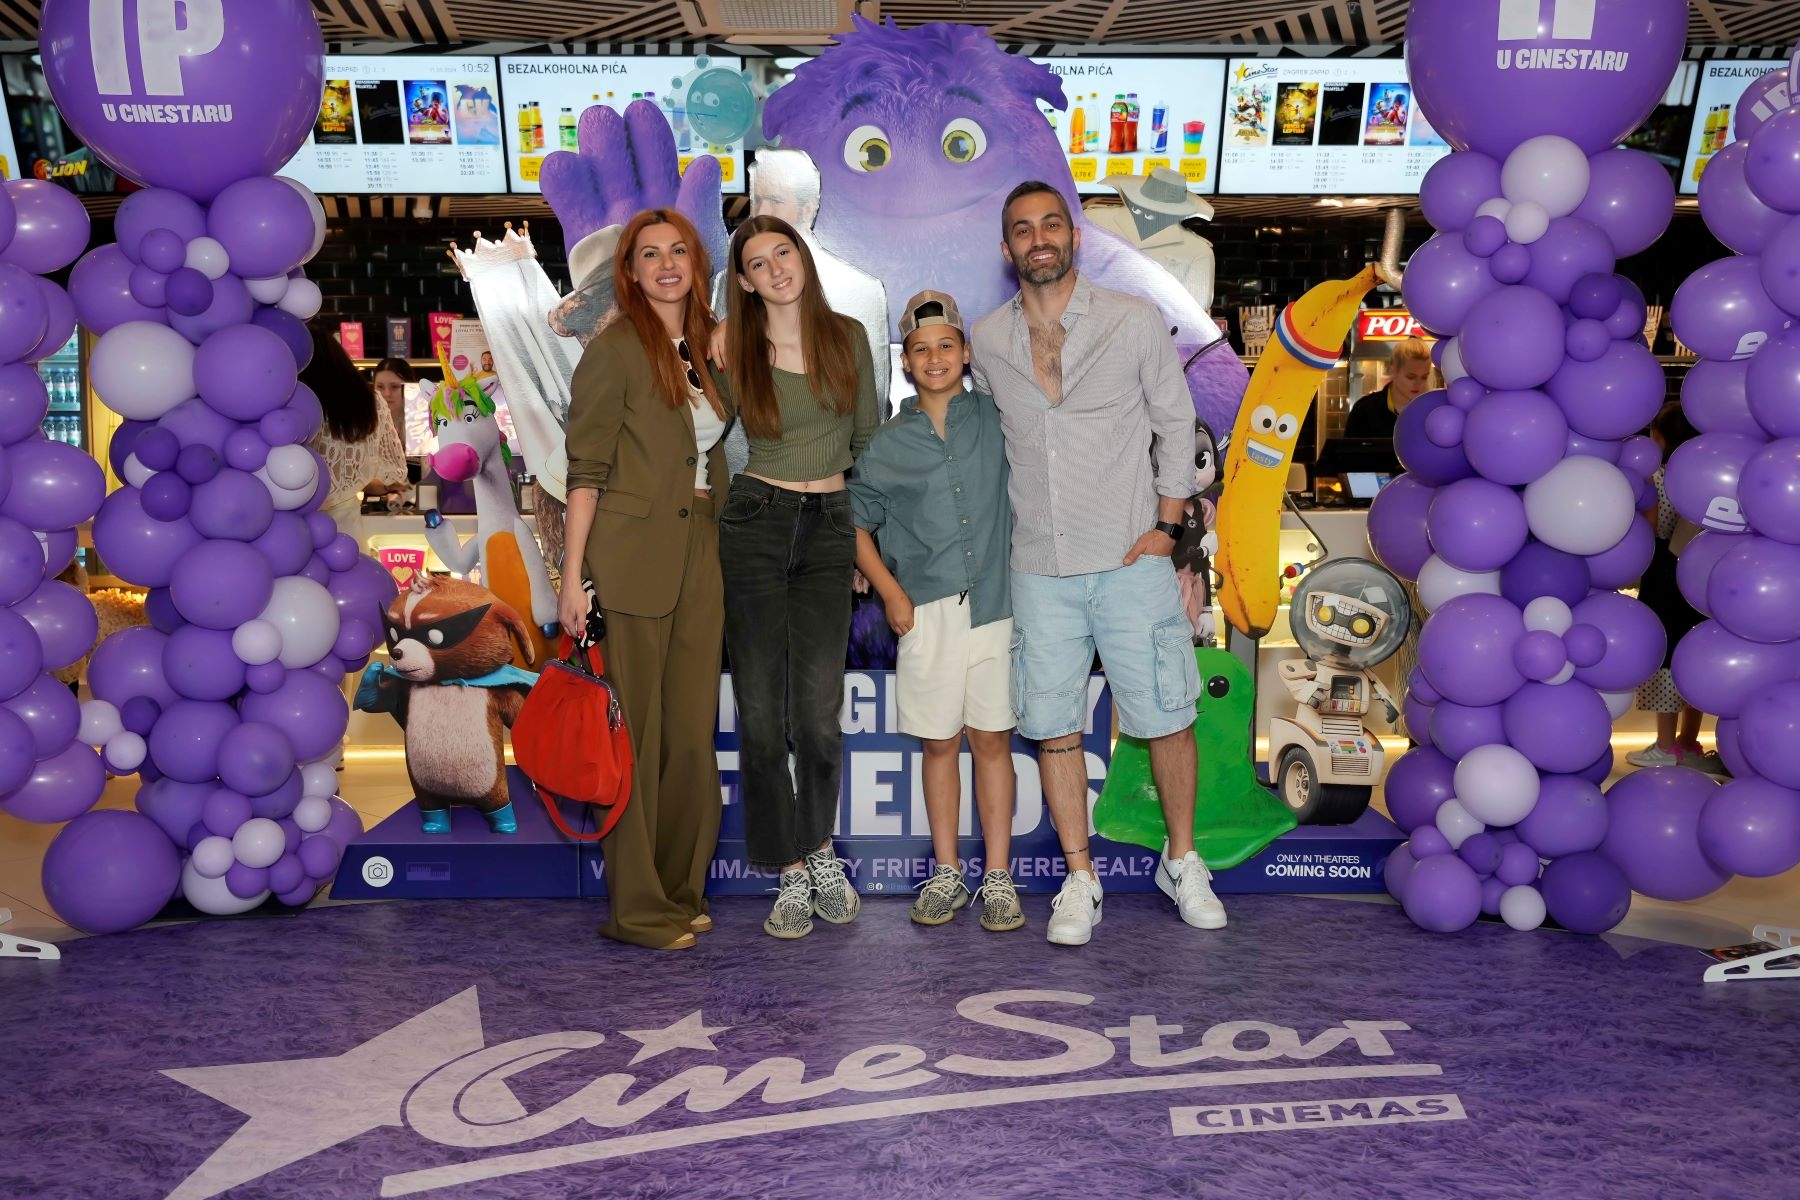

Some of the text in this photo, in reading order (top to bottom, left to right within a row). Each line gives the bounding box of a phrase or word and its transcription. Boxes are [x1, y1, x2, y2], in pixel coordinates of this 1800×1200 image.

[507, 60, 628, 75] BEZALKOHOLNA PIĆA
[1496, 48, 1628, 72] U CINESTARU
[462, 63, 490, 73] 10:52
[1087, 63, 1113, 76] PIĆA
[1243, 64, 1280, 79] CineStar
[102, 103, 233, 124] U CINESTARU
[52, 160, 88, 177] LION
[1251, 450, 1273, 466] tasty
[387, 552, 417, 563] LOVE
[1093, 856, 1155, 876] EAL?
[1276, 853, 1360, 864] ONLY IN THEATRES
[1265, 864, 1371, 879] COMING SOON
[404, 989, 1412, 1148] CineStar
[1195, 1098, 1450, 1129] CINEMAS
